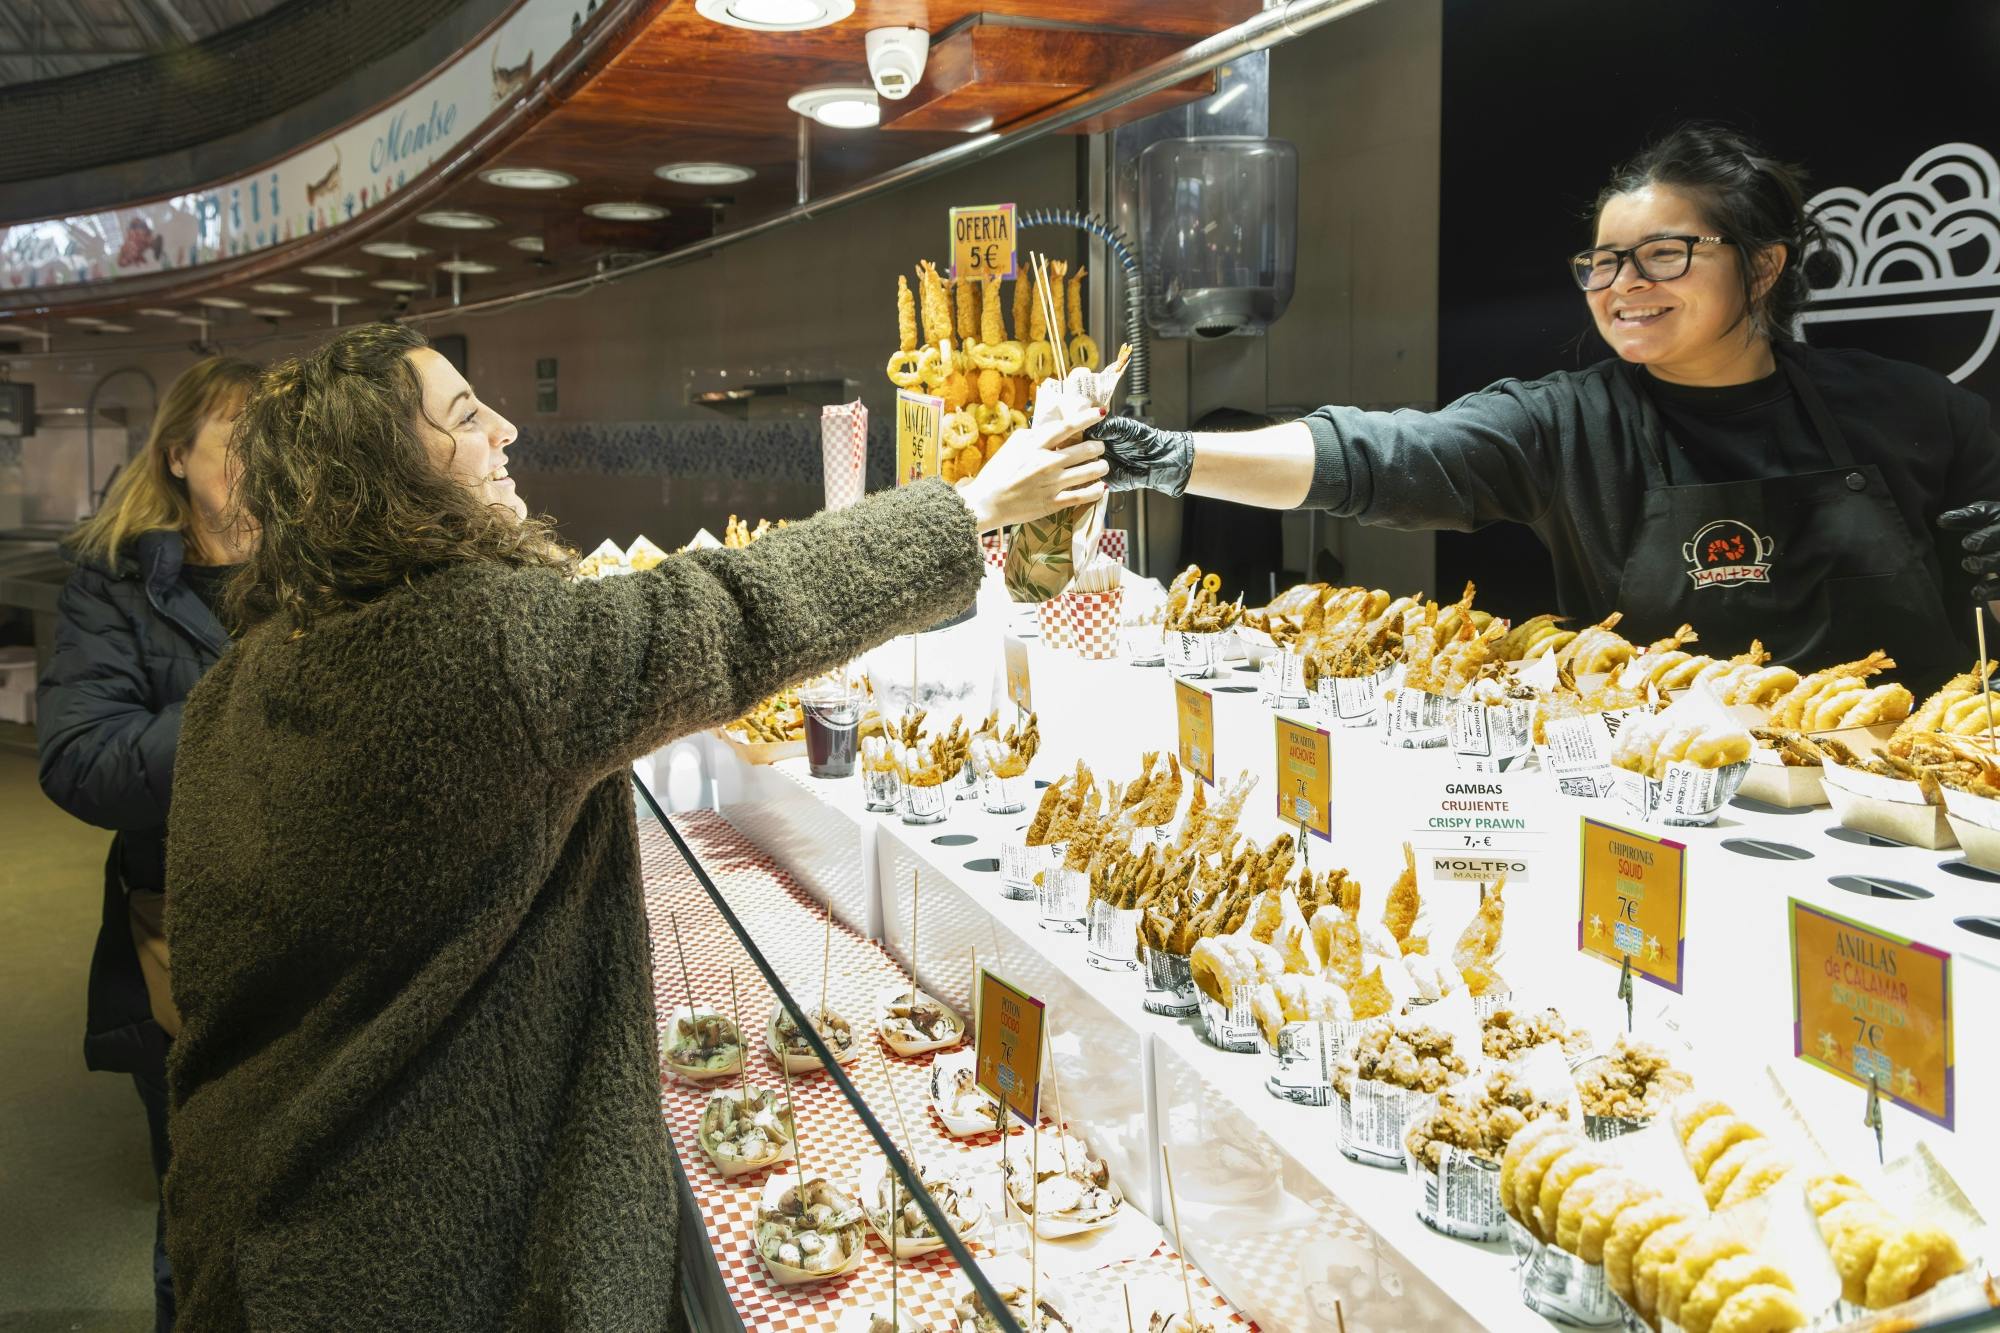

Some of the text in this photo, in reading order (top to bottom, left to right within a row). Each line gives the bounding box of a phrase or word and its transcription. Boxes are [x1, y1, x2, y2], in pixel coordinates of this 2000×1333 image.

[369, 100, 457, 174] Montse
[956, 214, 1008, 241] OFERTA
[1445, 784, 1503, 794] GAMBAS
[1441, 800, 1509, 811] CRUJIENTE
[1428, 817, 1525, 829] CRISPY PRAWN
[1608, 840, 1655, 866] CHIPIRONES
[1618, 858, 1643, 880] SQUID
[1836, 931, 1897, 977] ANILLAS
[1824, 955, 1909, 1008] de CALAMAR
